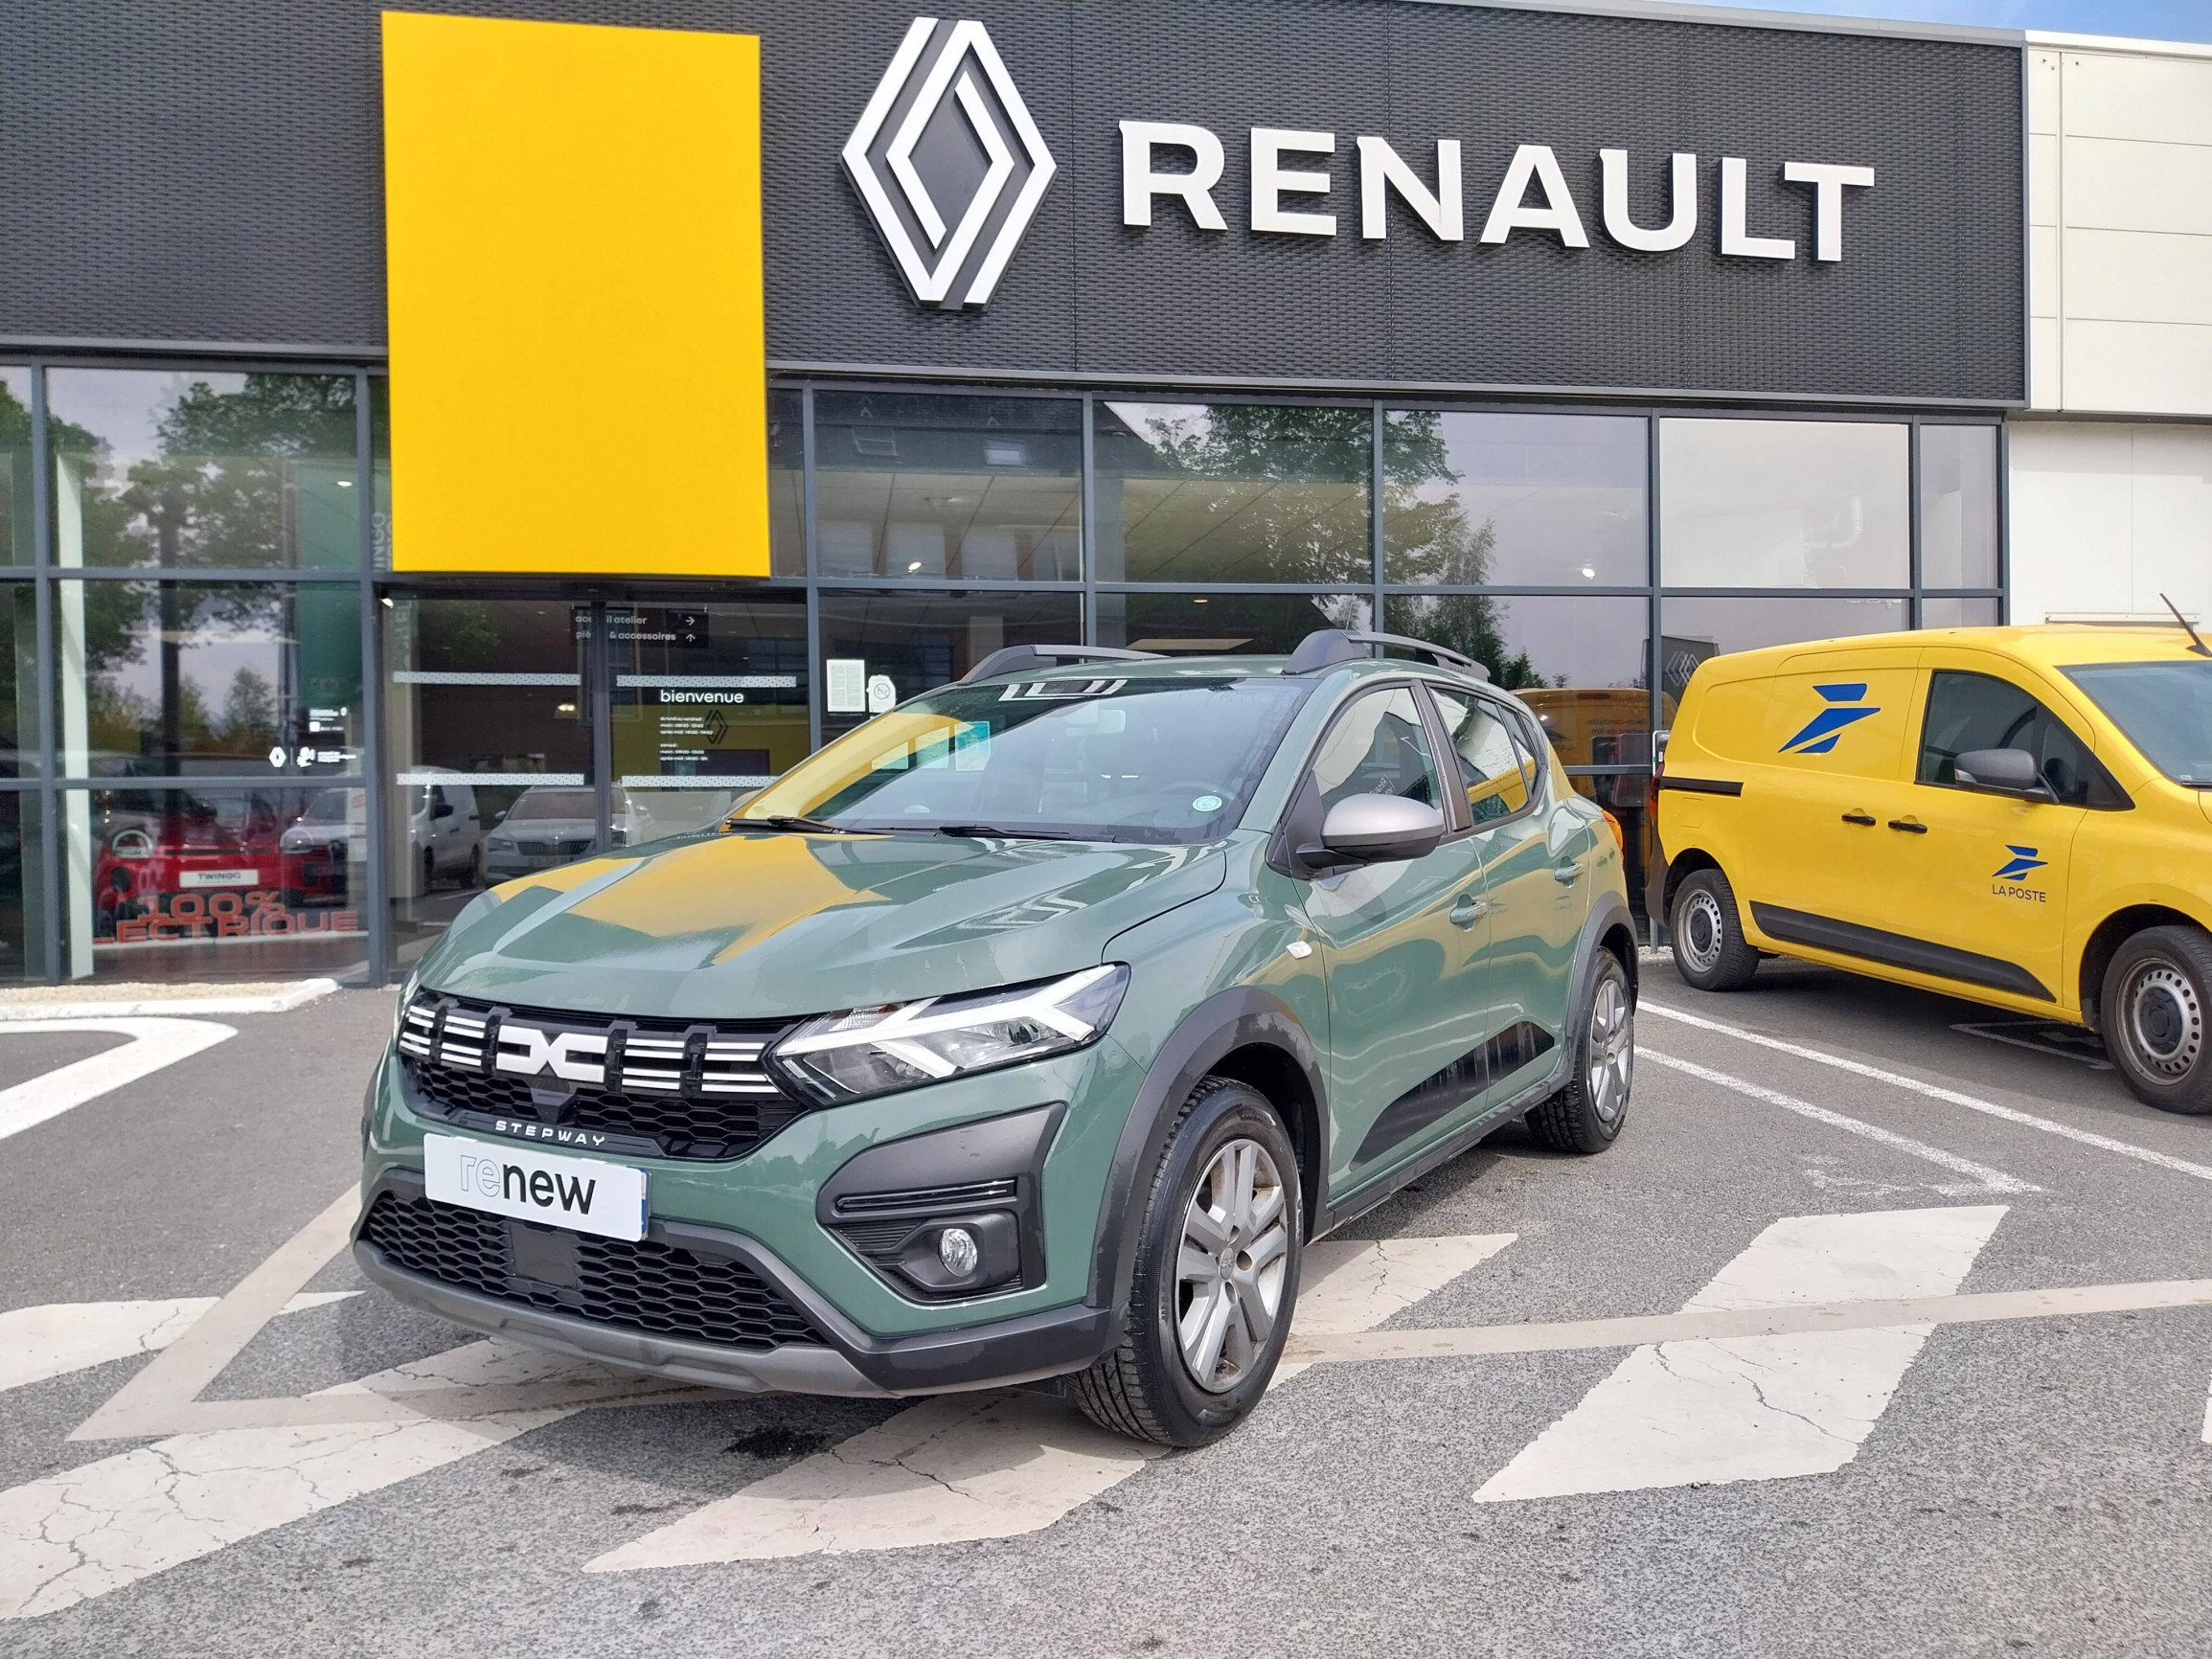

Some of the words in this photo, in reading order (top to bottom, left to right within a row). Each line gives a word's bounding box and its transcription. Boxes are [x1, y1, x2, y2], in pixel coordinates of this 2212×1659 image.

[1119, 120, 1875, 262] RENAULT
[614, 616, 648, 625] atelier
[618, 632, 676, 641] accessoires
[660, 689, 744, 703] bienvenue
[198, 871, 241, 880] TWINGO
[1992, 883, 2007, 897] LA
[2008, 886, 2046, 903] POSTE
[136, 890, 286, 922] 100%
[494, 1120, 605, 1147] STEPWAY
[460, 1154, 596, 1216] renew
